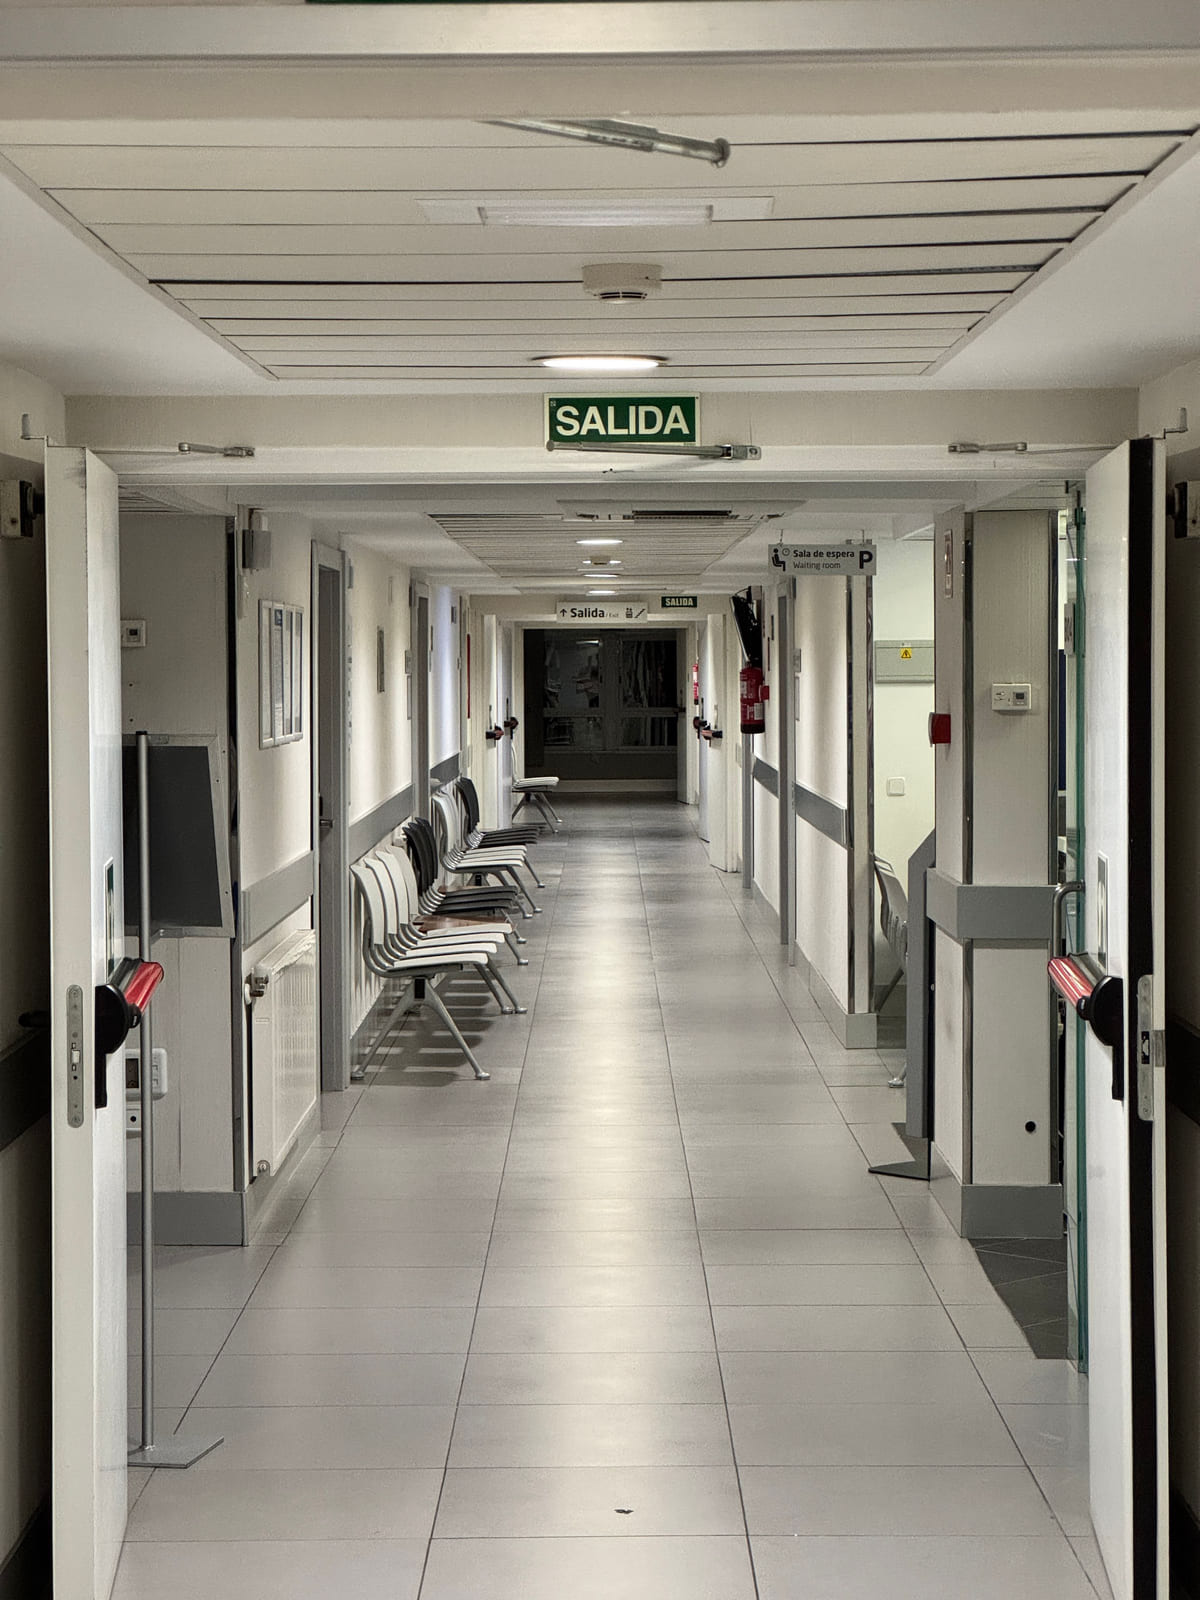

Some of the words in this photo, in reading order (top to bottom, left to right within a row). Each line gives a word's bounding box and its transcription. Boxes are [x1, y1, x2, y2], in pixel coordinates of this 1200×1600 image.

[555, 405, 690, 436] SALIDA
[793, 549, 811, 558] Sala
[813, 549, 825, 558] de
[826, 550, 855, 559] espera
[859, 550, 873, 569] P
[793, 561, 821, 570] Waiting
[665, 597, 694, 606] SALIDA
[570, 607, 605, 618] Salida
